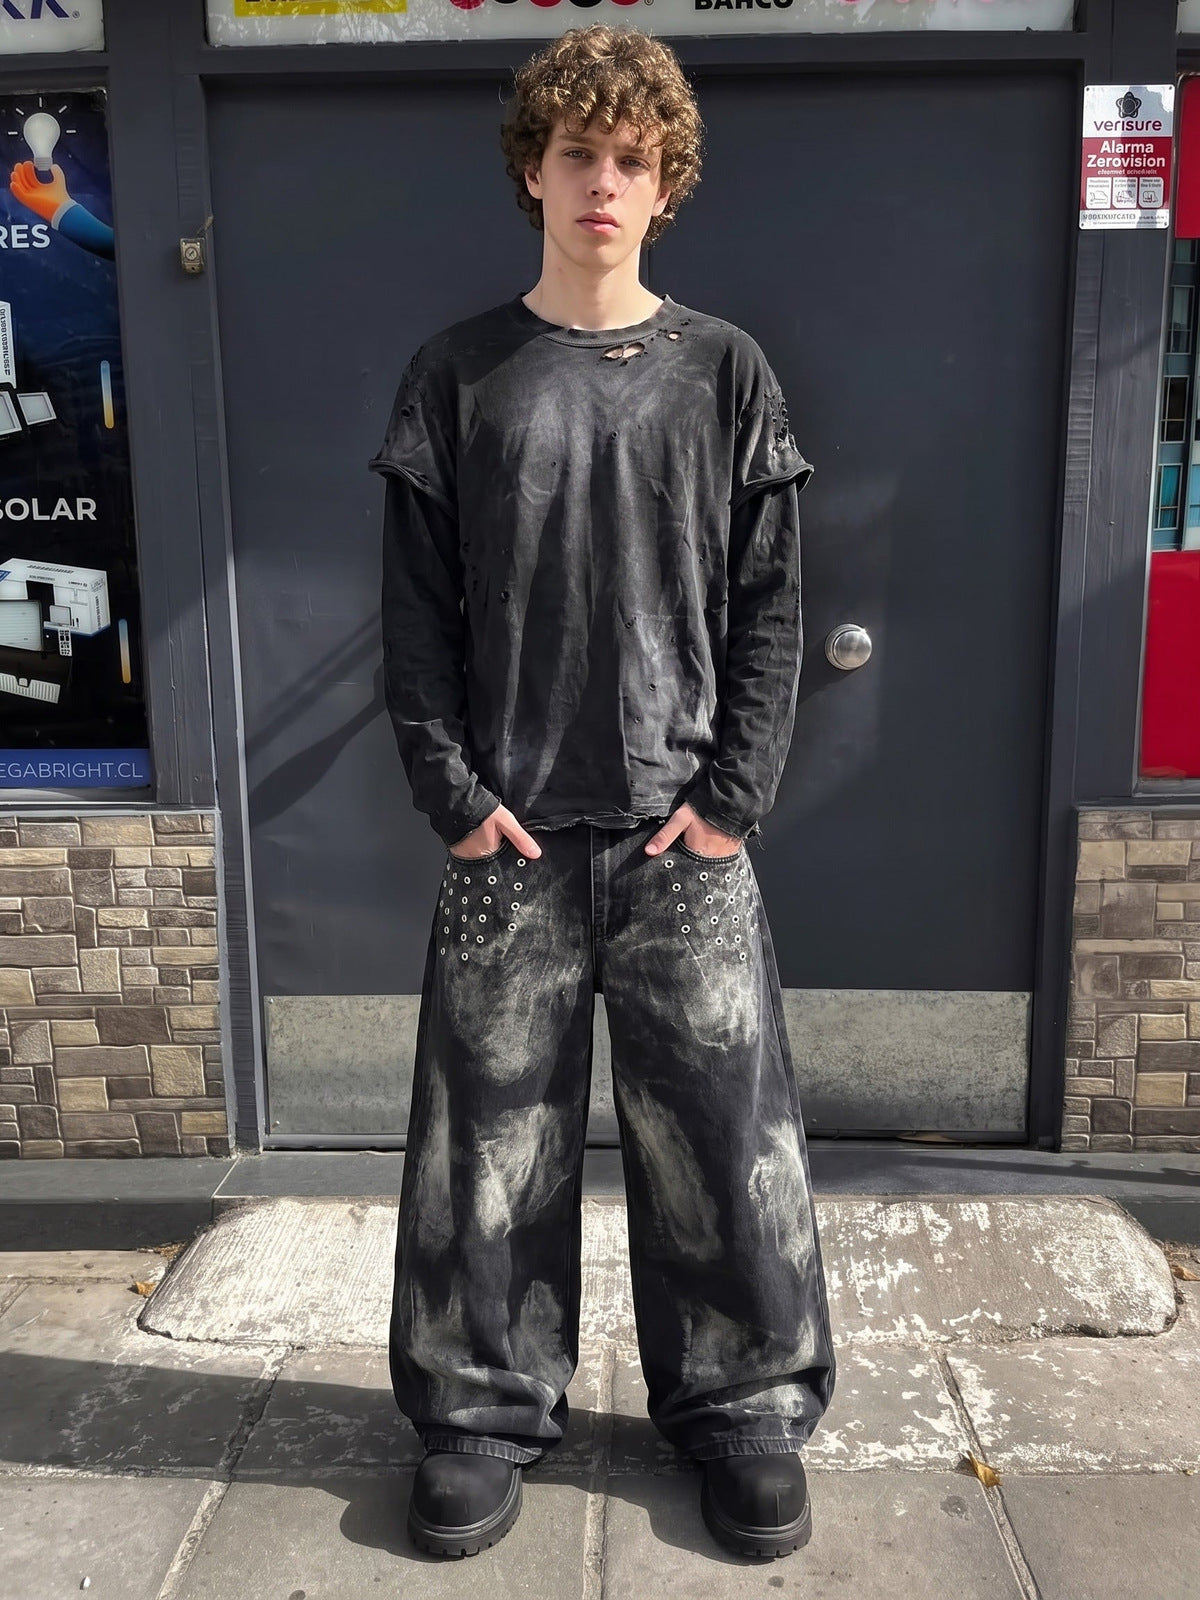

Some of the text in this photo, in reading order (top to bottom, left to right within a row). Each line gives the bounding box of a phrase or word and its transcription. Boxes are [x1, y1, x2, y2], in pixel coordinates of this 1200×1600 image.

[1093, 120, 1162, 132] verisure
[1100, 140, 1154, 154] Alarma
[1086, 155, 1166, 168] Zerovision
[0, 497, 98, 521] OLAR
